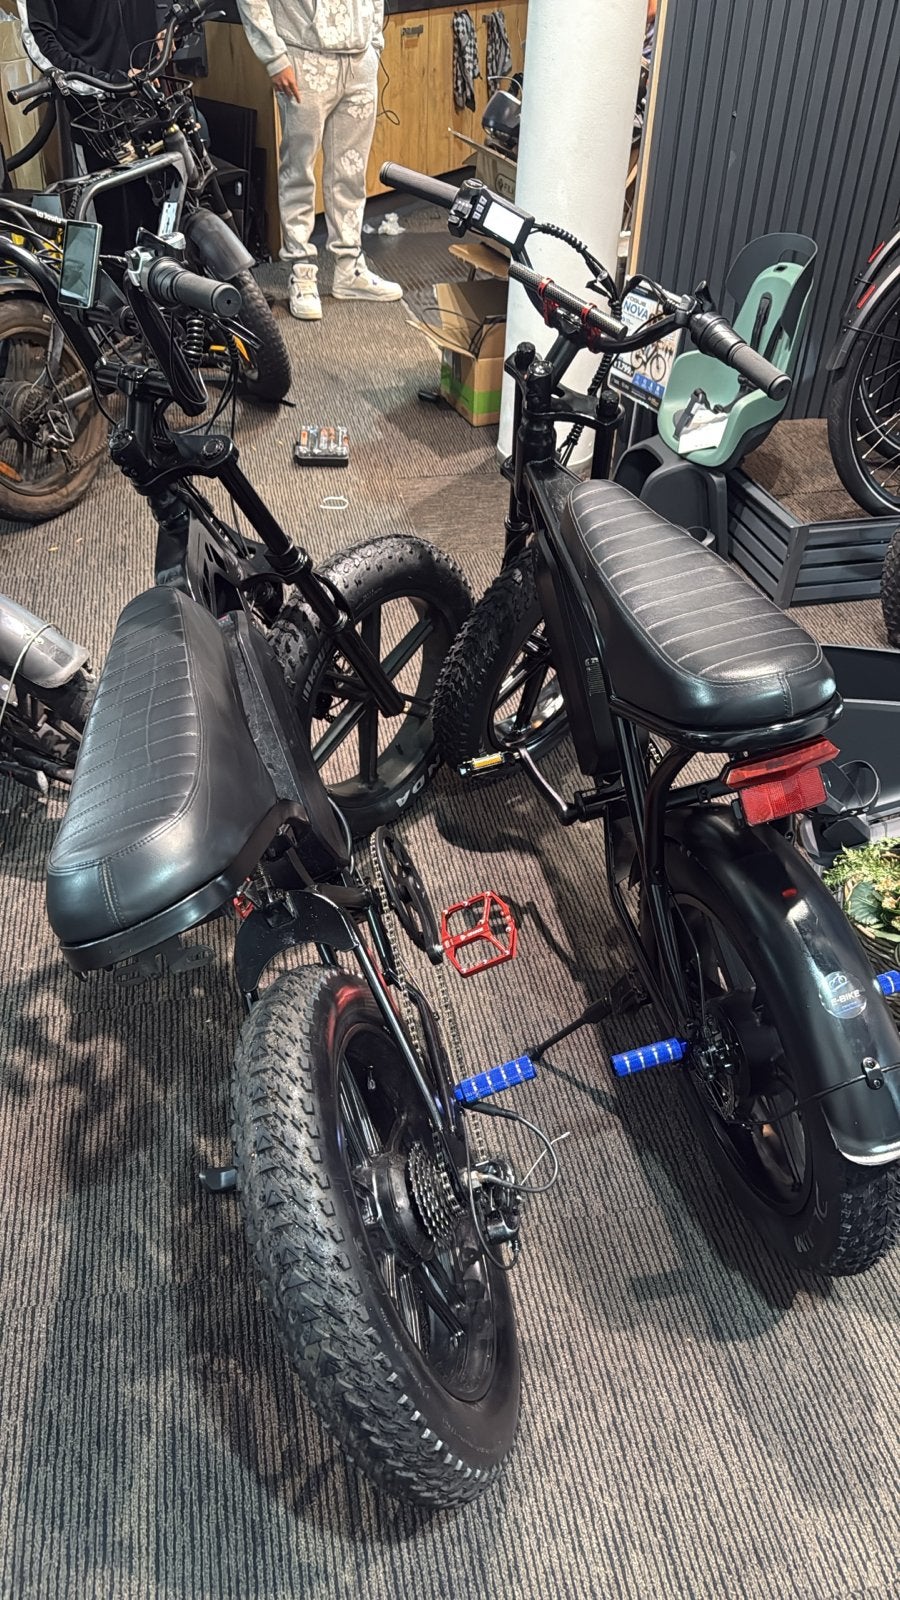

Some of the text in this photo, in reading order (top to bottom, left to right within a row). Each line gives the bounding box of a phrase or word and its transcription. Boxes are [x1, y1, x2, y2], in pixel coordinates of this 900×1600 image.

[623, 300, 648, 320] NOVA
[396, 753, 440, 807] NDA
[831, 989, 861, 1006] E-BIKE
